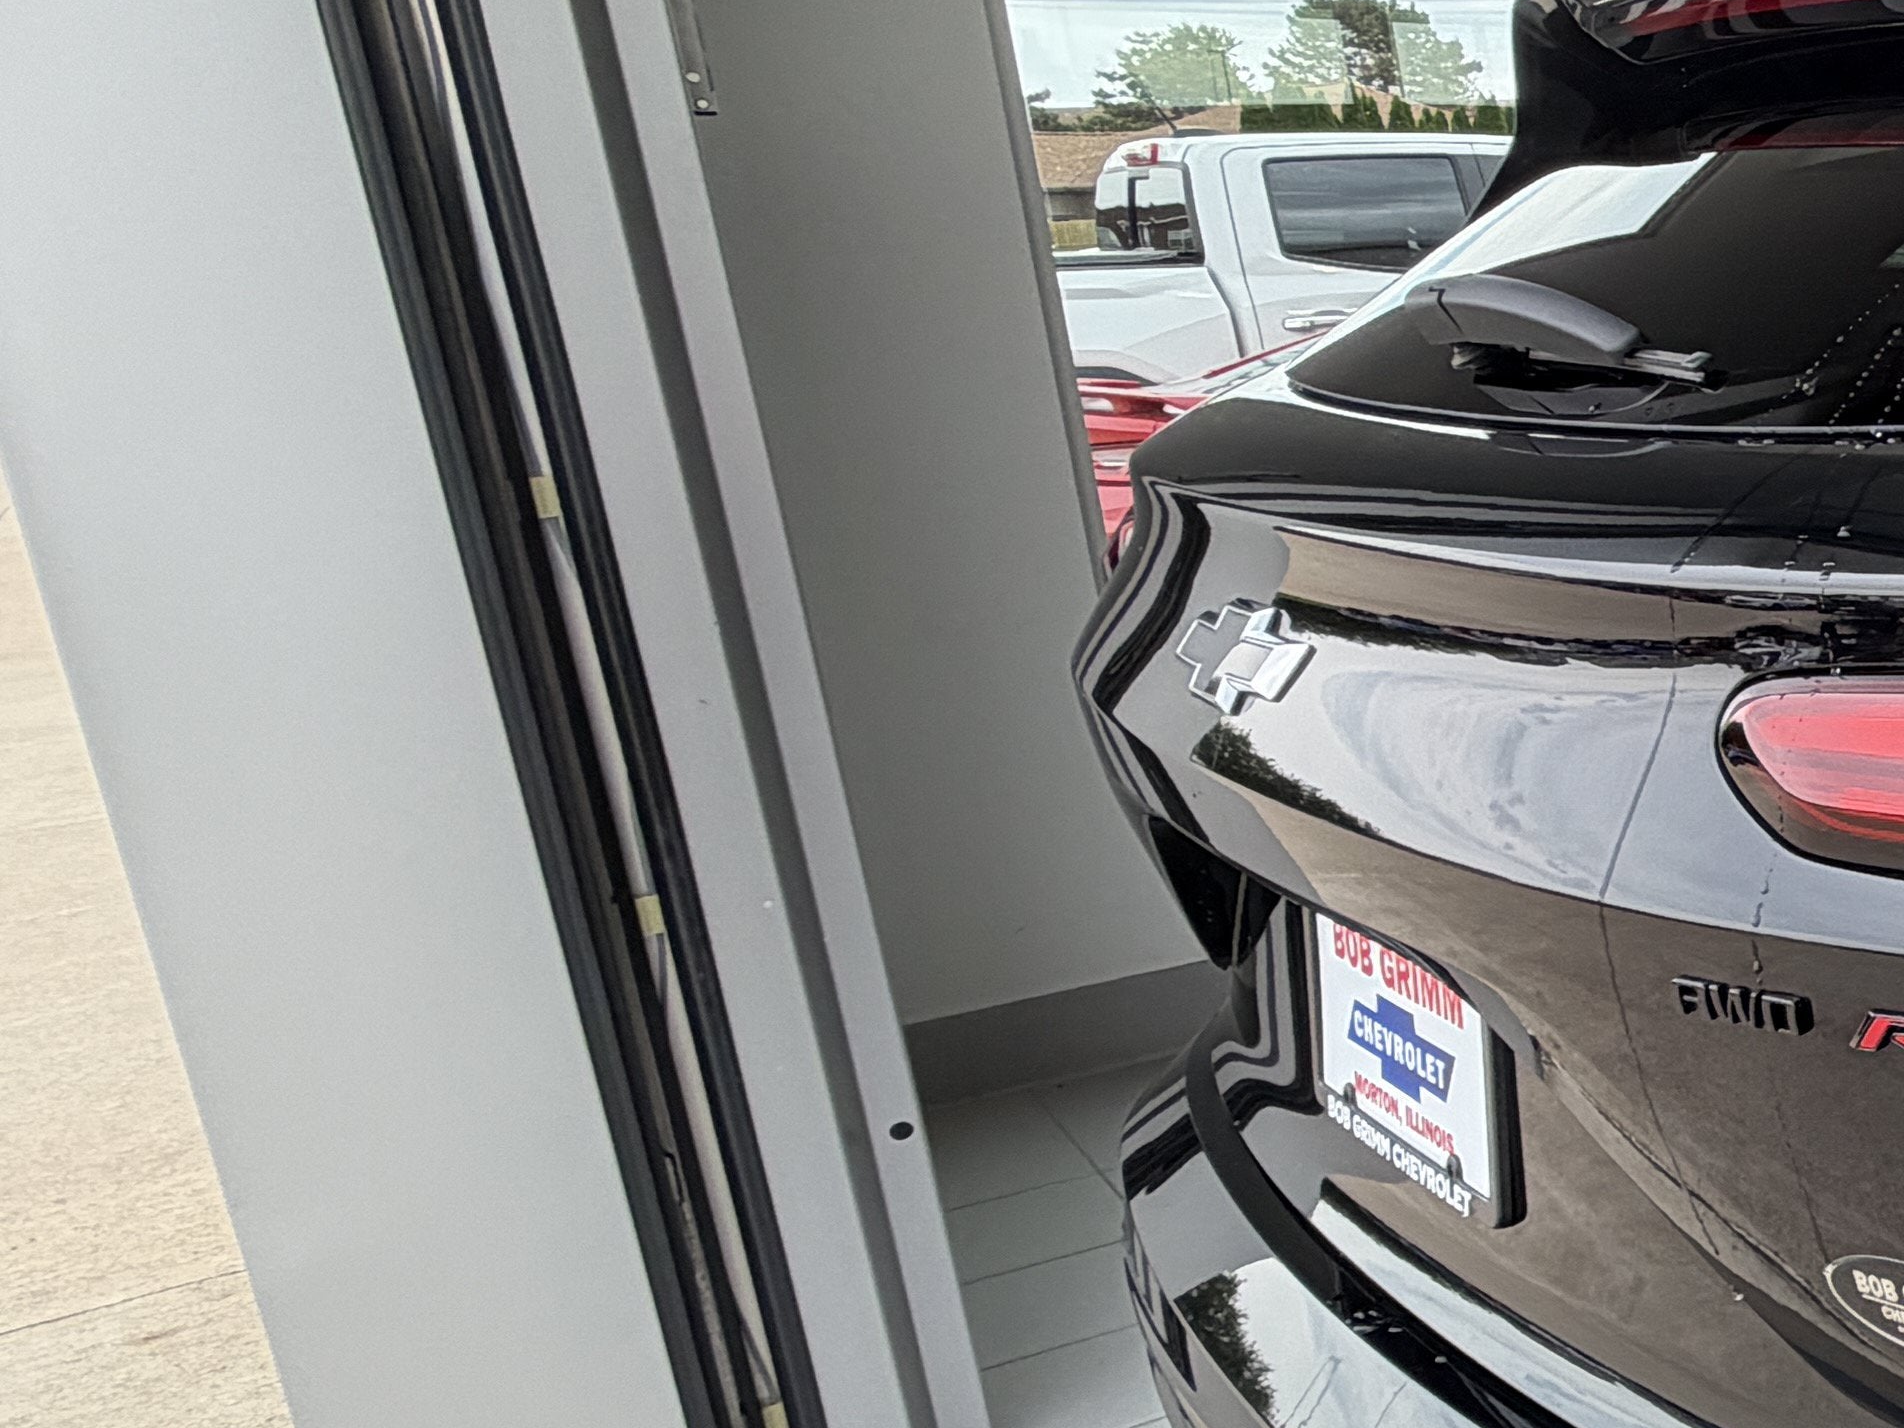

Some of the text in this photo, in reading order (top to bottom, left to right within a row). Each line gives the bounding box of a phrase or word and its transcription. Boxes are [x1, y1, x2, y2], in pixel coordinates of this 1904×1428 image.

[1333, 923, 1464, 1029] BOB GRIMM
[1353, 1009, 1447, 1090] CHEVROLET
[1326, 1094, 1472, 1218] BOB GRIMM CHEVROLET
[1405, 1105, 1455, 1155] ILLINOIS
[1852, 1269, 1899, 1303] BOB
